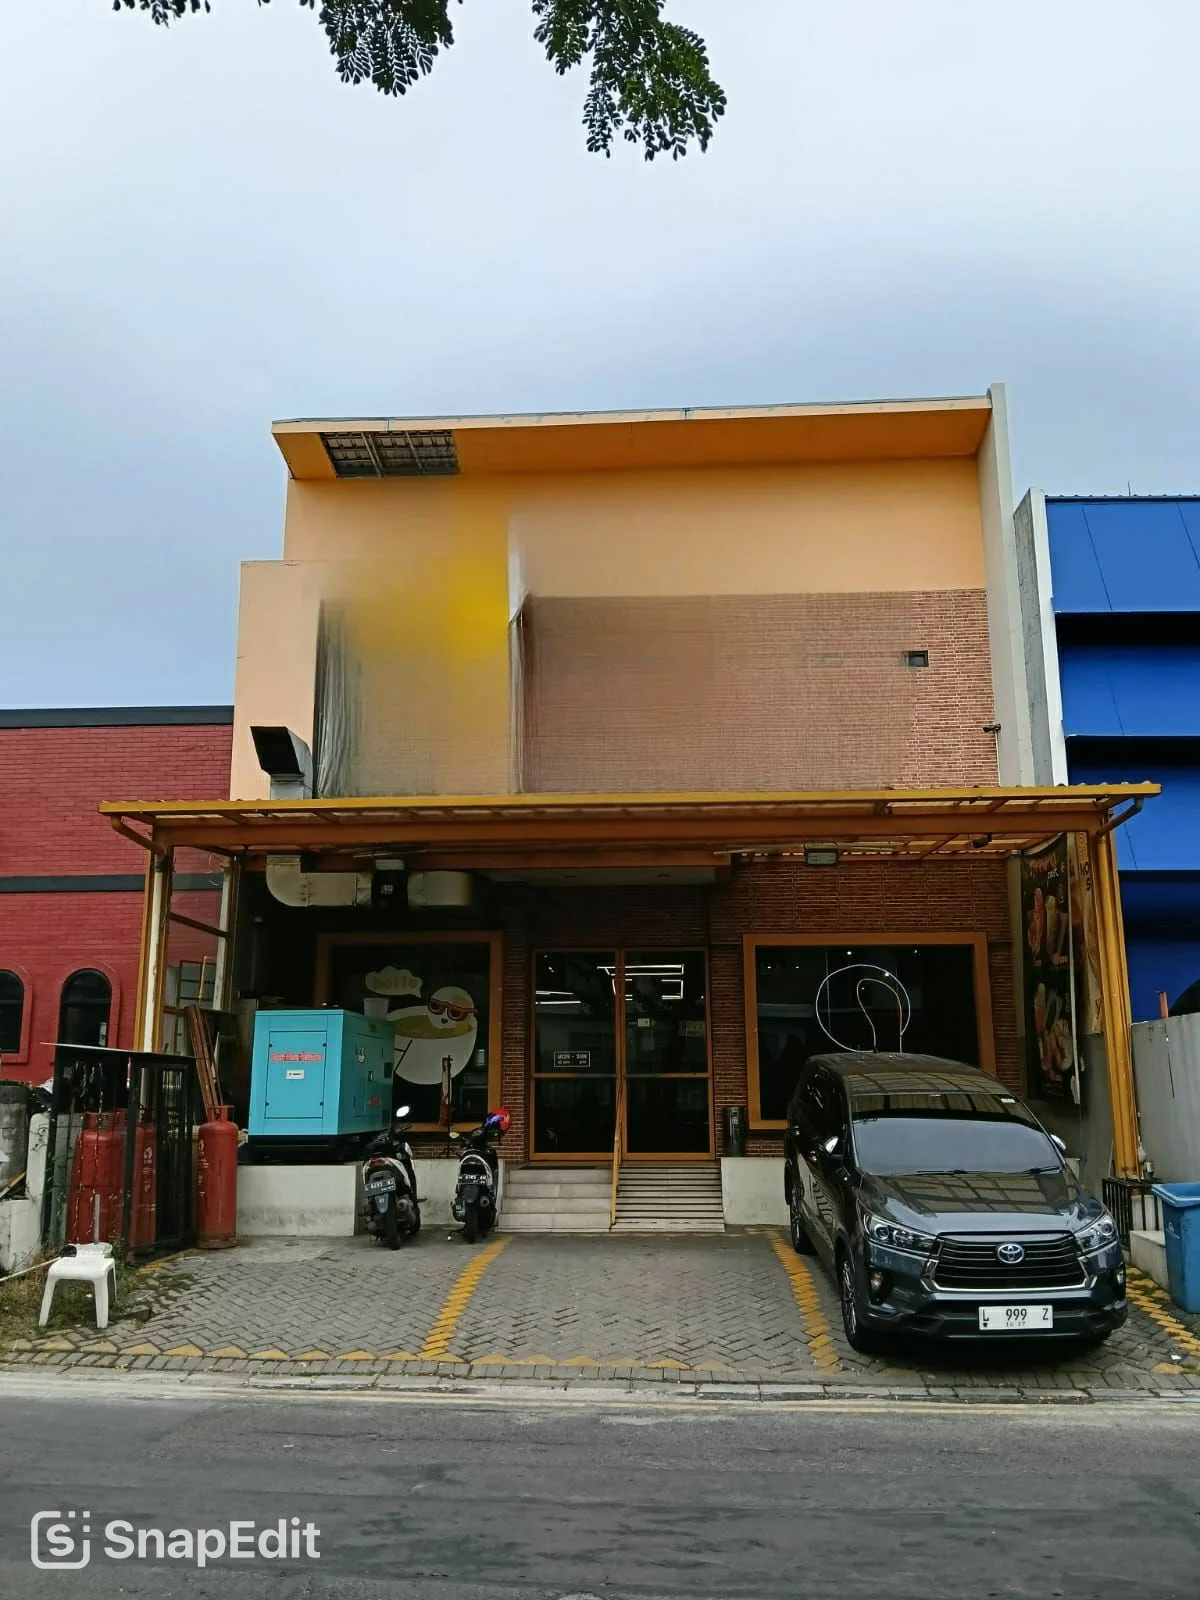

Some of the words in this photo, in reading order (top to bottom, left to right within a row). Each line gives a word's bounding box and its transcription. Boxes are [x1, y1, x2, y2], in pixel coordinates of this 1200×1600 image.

[982, 1309, 989, 1322] L
[1005, 1308, 1027, 1321] 999
[1042, 1308, 1049, 1321] Z
